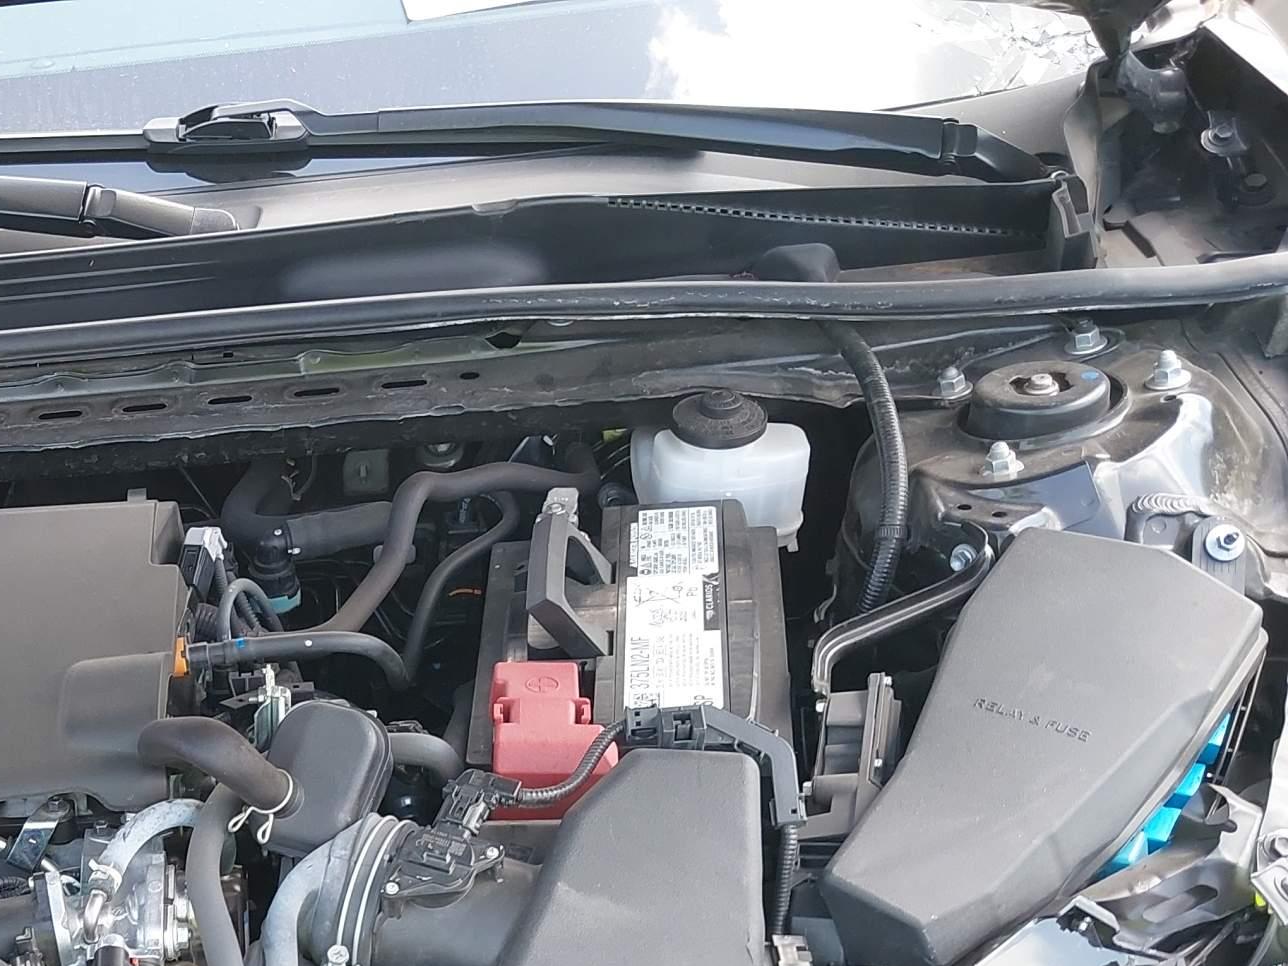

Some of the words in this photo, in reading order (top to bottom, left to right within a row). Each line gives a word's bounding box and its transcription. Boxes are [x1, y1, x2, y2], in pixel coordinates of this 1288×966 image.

[973, 698, 1023, 721] RELAY
[1028, 715, 1041, 727] &
[1044, 719, 1091, 743] FUSE
